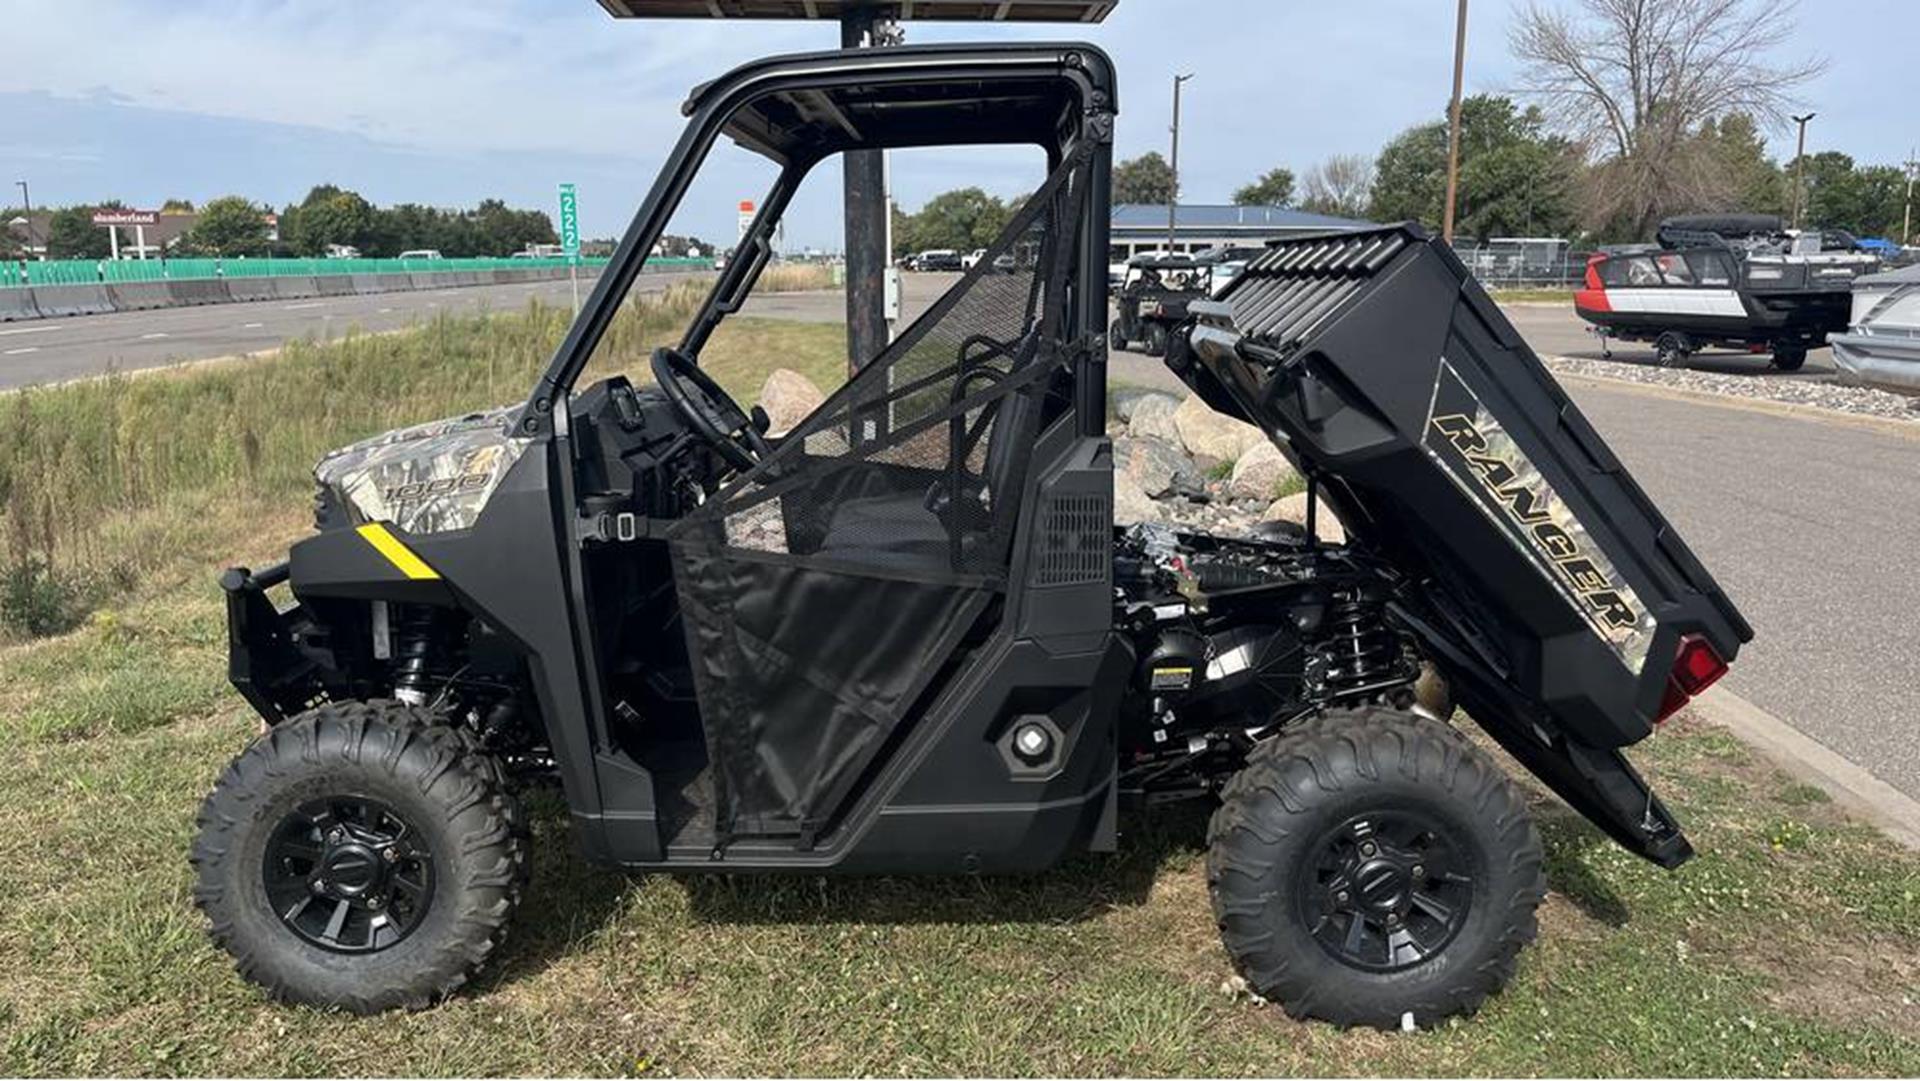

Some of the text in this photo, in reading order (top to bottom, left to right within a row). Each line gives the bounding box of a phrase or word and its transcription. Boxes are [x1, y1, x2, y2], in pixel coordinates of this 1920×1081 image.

[563, 196, 576, 247] 222
[386, 474, 488, 501] 1000
[1432, 414, 1639, 630] RANGER
